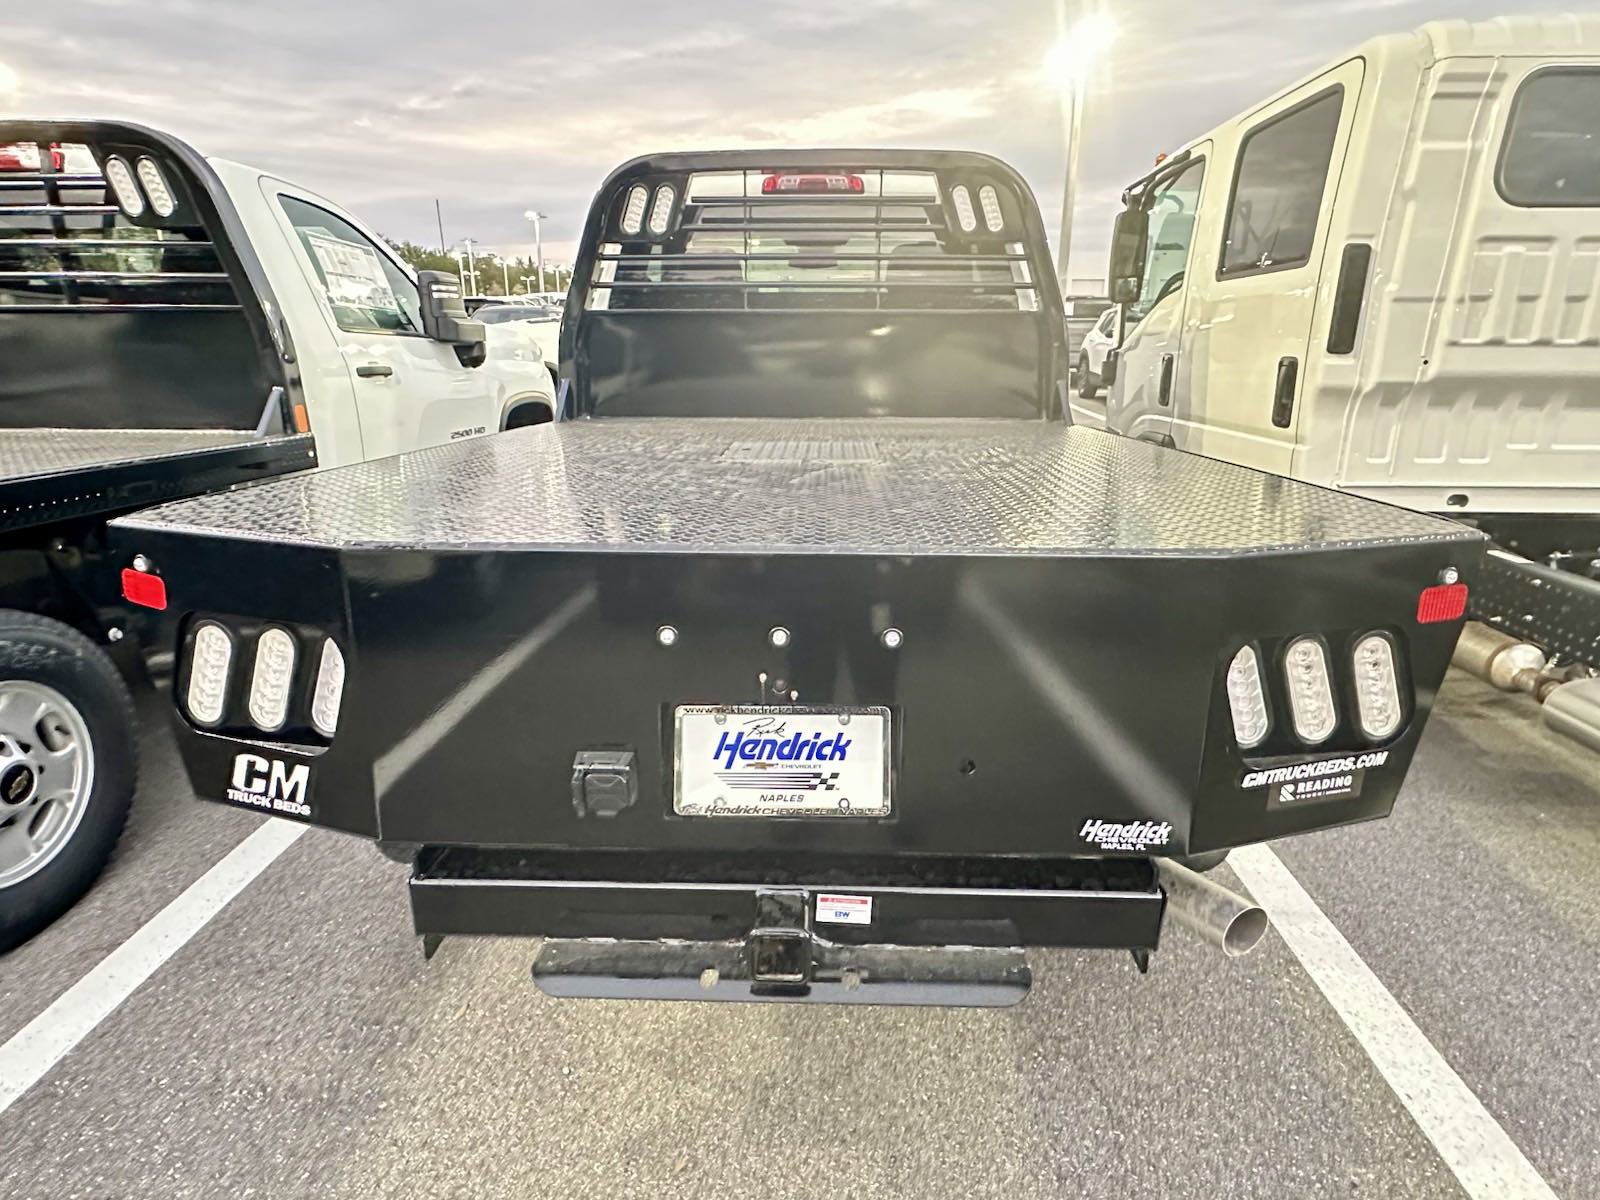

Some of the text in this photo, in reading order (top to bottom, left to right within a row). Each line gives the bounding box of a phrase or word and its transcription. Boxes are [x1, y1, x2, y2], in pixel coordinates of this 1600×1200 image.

[450, 426, 486, 439] 2500 HD
[713, 732, 852, 769] Hendrick
[232, 753, 310, 804] CM
[1241, 751, 1389, 788] CMTRUCKBEDS.COM
[1296, 775, 1353, 793] READING
[226, 788, 311, 816] TRUCK BEDS
[759, 794, 805, 802] NAPLES
[704, 805, 762, 816] Hendrick
[1079, 819, 1173, 842] Hendrick
[1094, 836, 1169, 845] CHEVROLET
